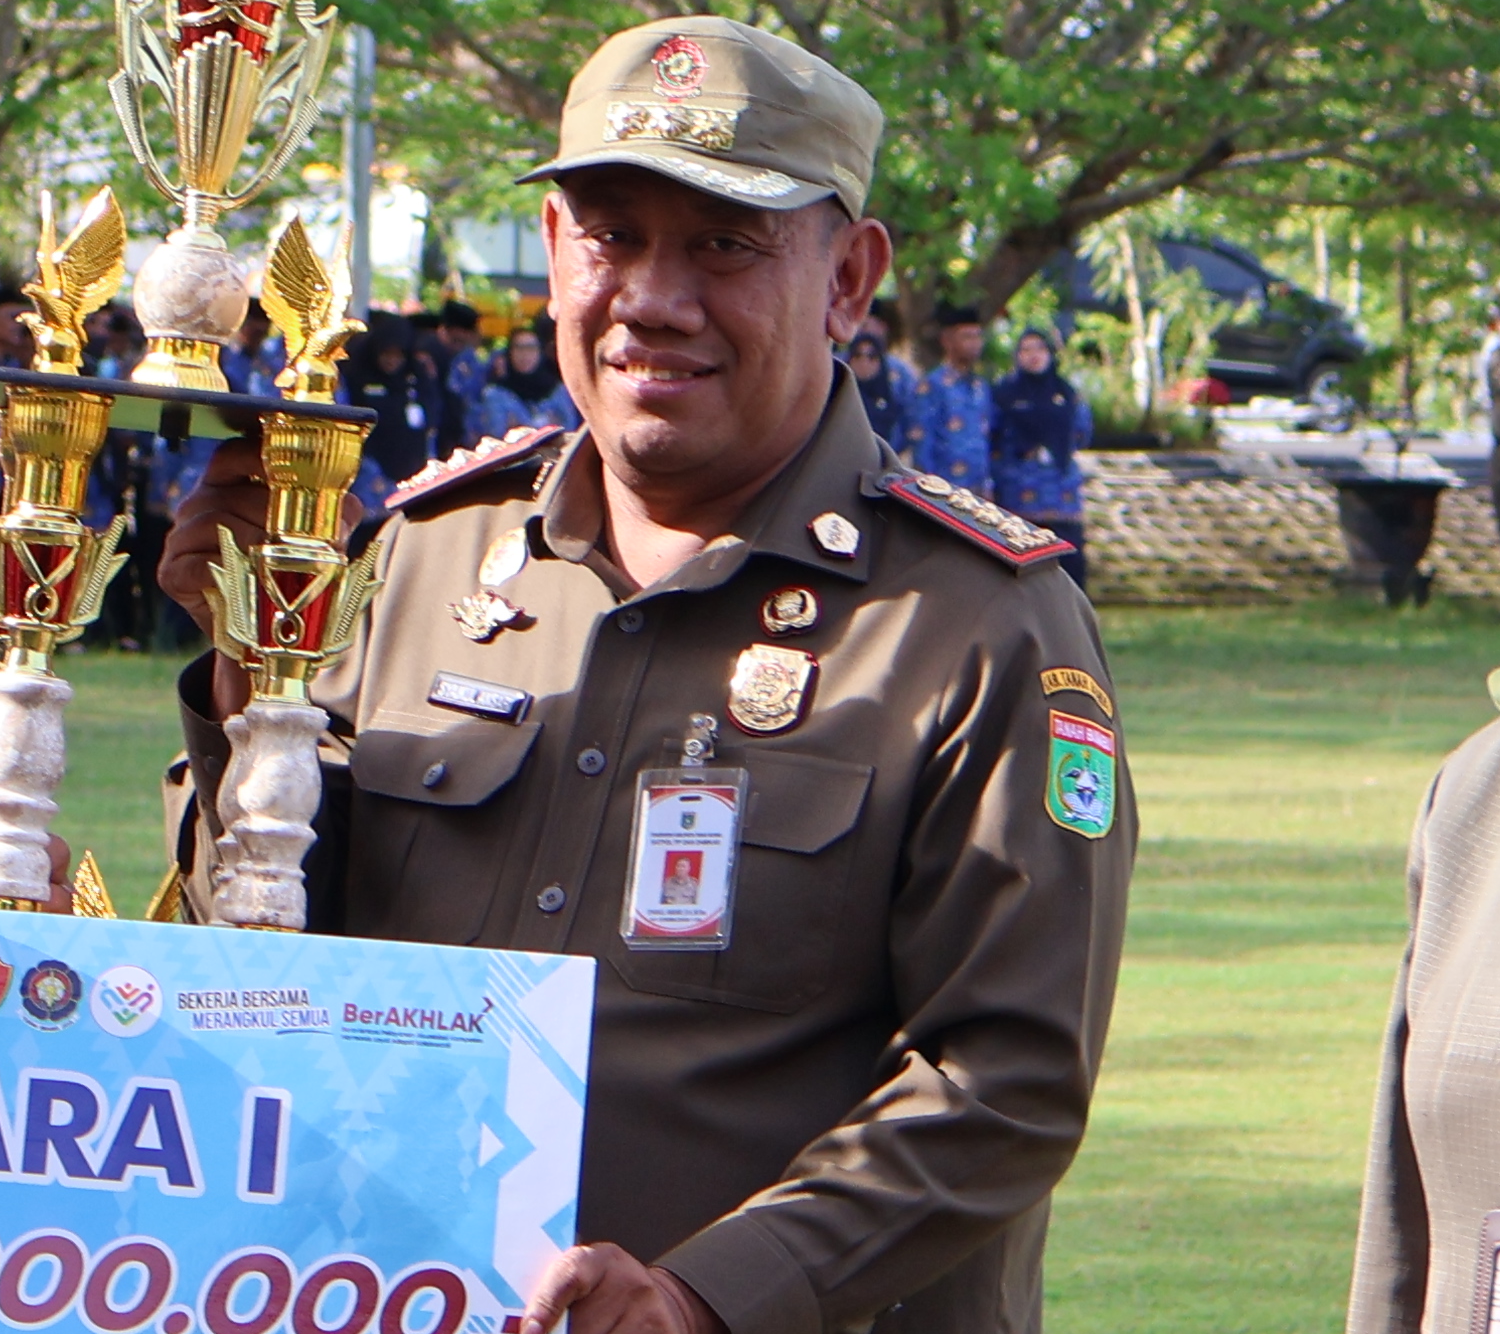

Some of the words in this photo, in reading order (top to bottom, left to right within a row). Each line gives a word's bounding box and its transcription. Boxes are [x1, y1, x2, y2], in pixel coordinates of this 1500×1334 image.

[177, 991, 239, 1010] BEKERJA
[242, 990, 309, 1008] BERSAMA
[192, 1011, 278, 1031] MERANGKUL
[280, 1009, 330, 1028] SEMUA
[342, 1002, 485, 1034] BerAKHLAK
[246, 1096, 282, 1195] I
